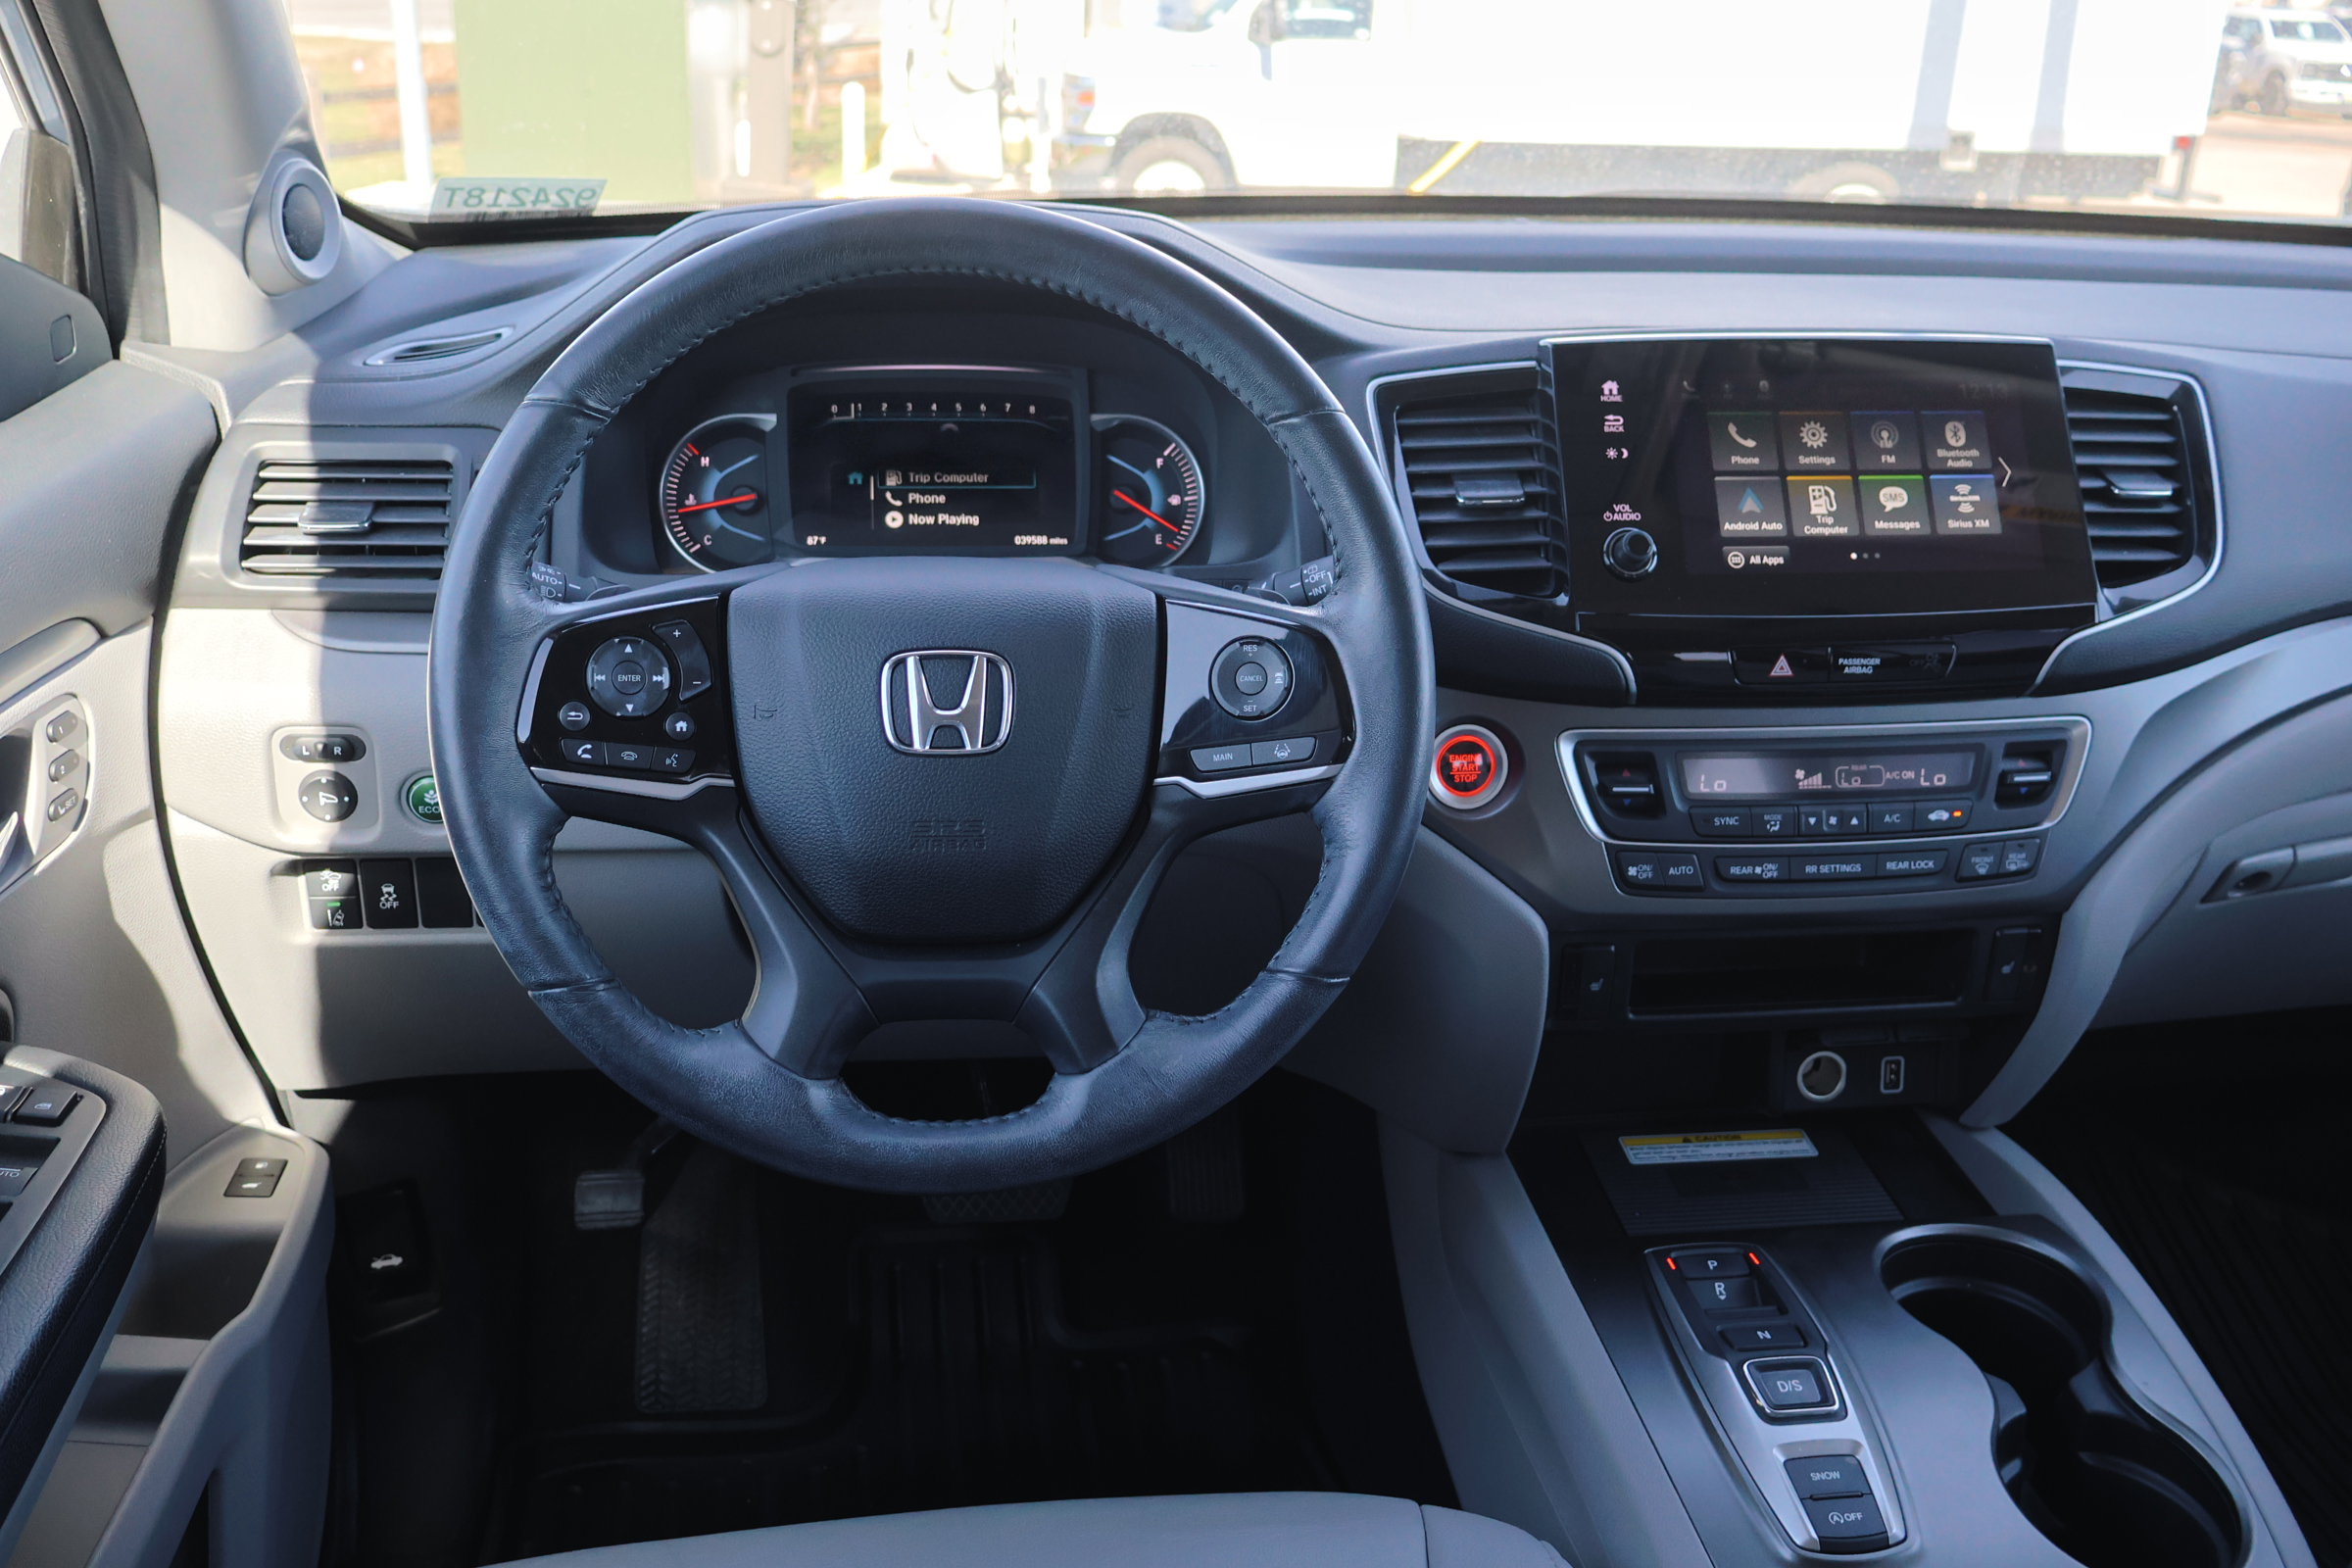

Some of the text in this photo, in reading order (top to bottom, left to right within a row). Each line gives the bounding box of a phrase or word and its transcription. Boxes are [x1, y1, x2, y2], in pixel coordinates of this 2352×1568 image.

[830, 403, 1036, 415] 0 1 2 3 4 5 6 7 8
[1936, 448, 1981, 459] Bluetooth
[700, 456, 710, 467] H
[1156, 458, 1164, 468] F
[1731, 455, 1760, 466] Phone
[1798, 455, 1837, 466] Settings
[1881, 455, 1896, 465] FM
[1946, 458, 1974, 468] Audio
[908, 472, 990, 484] Trip Computer
[907, 493, 947, 505] Phone
[1882, 492, 1905, 503] SMS
[1612, 504, 1633, 513] VOL
[907, 514, 980, 526] Now Playing
[1612, 513, 1642, 521] AUDIO
[1816, 514, 1835, 525] Trip
[1724, 520, 1784, 531] Android Auto
[1874, 519, 1921, 531] Messages
[1947, 518, 1990, 529] Sirius XM
[1804, 524, 1848, 535] Computer
[704, 534, 712, 546] C
[1014, 535, 1068, 546] 039588 miles
[1154, 533, 1163, 545] E
[1749, 555, 1785, 565] All Apps
[532, 571, 558, 585] AUTO
[1309, 571, 1326, 584] OFF
[1312, 585, 1327, 597] INT
[1838, 658, 1882, 666] PASSENGER
[302, 745, 342, 756] L R
[1212, 753, 1234, 762] MAIN
[1451, 763, 1480, 772] START
[1454, 774, 1478, 783] STOP
[1886, 770, 1915, 780] A/C ON
[1920, 767, 1947, 786] Lo
[1699, 773, 1728, 793] Lo
[1714, 815, 1740, 826] SYNC
[1884, 813, 1901, 823] A/C
[1730, 865, 1753, 875] REAR
[1805, 862, 1862, 874] RR SETTINGS
[1886, 859, 1935, 870] REAR LOCK
[1669, 866, 1694, 875] AUTO
[1762, 870, 1779, 879] OFF
[379, 901, 400, 909] OFF
[1707, 1259, 1718, 1270] P
[1715, 1282, 1726, 1296] R
[1756, 1330, 1772, 1340] N
[1777, 1379, 1803, 1394] D/S
[1810, 1471, 1840, 1481] SNOW
[1844, 1512, 1863, 1522] OFF
